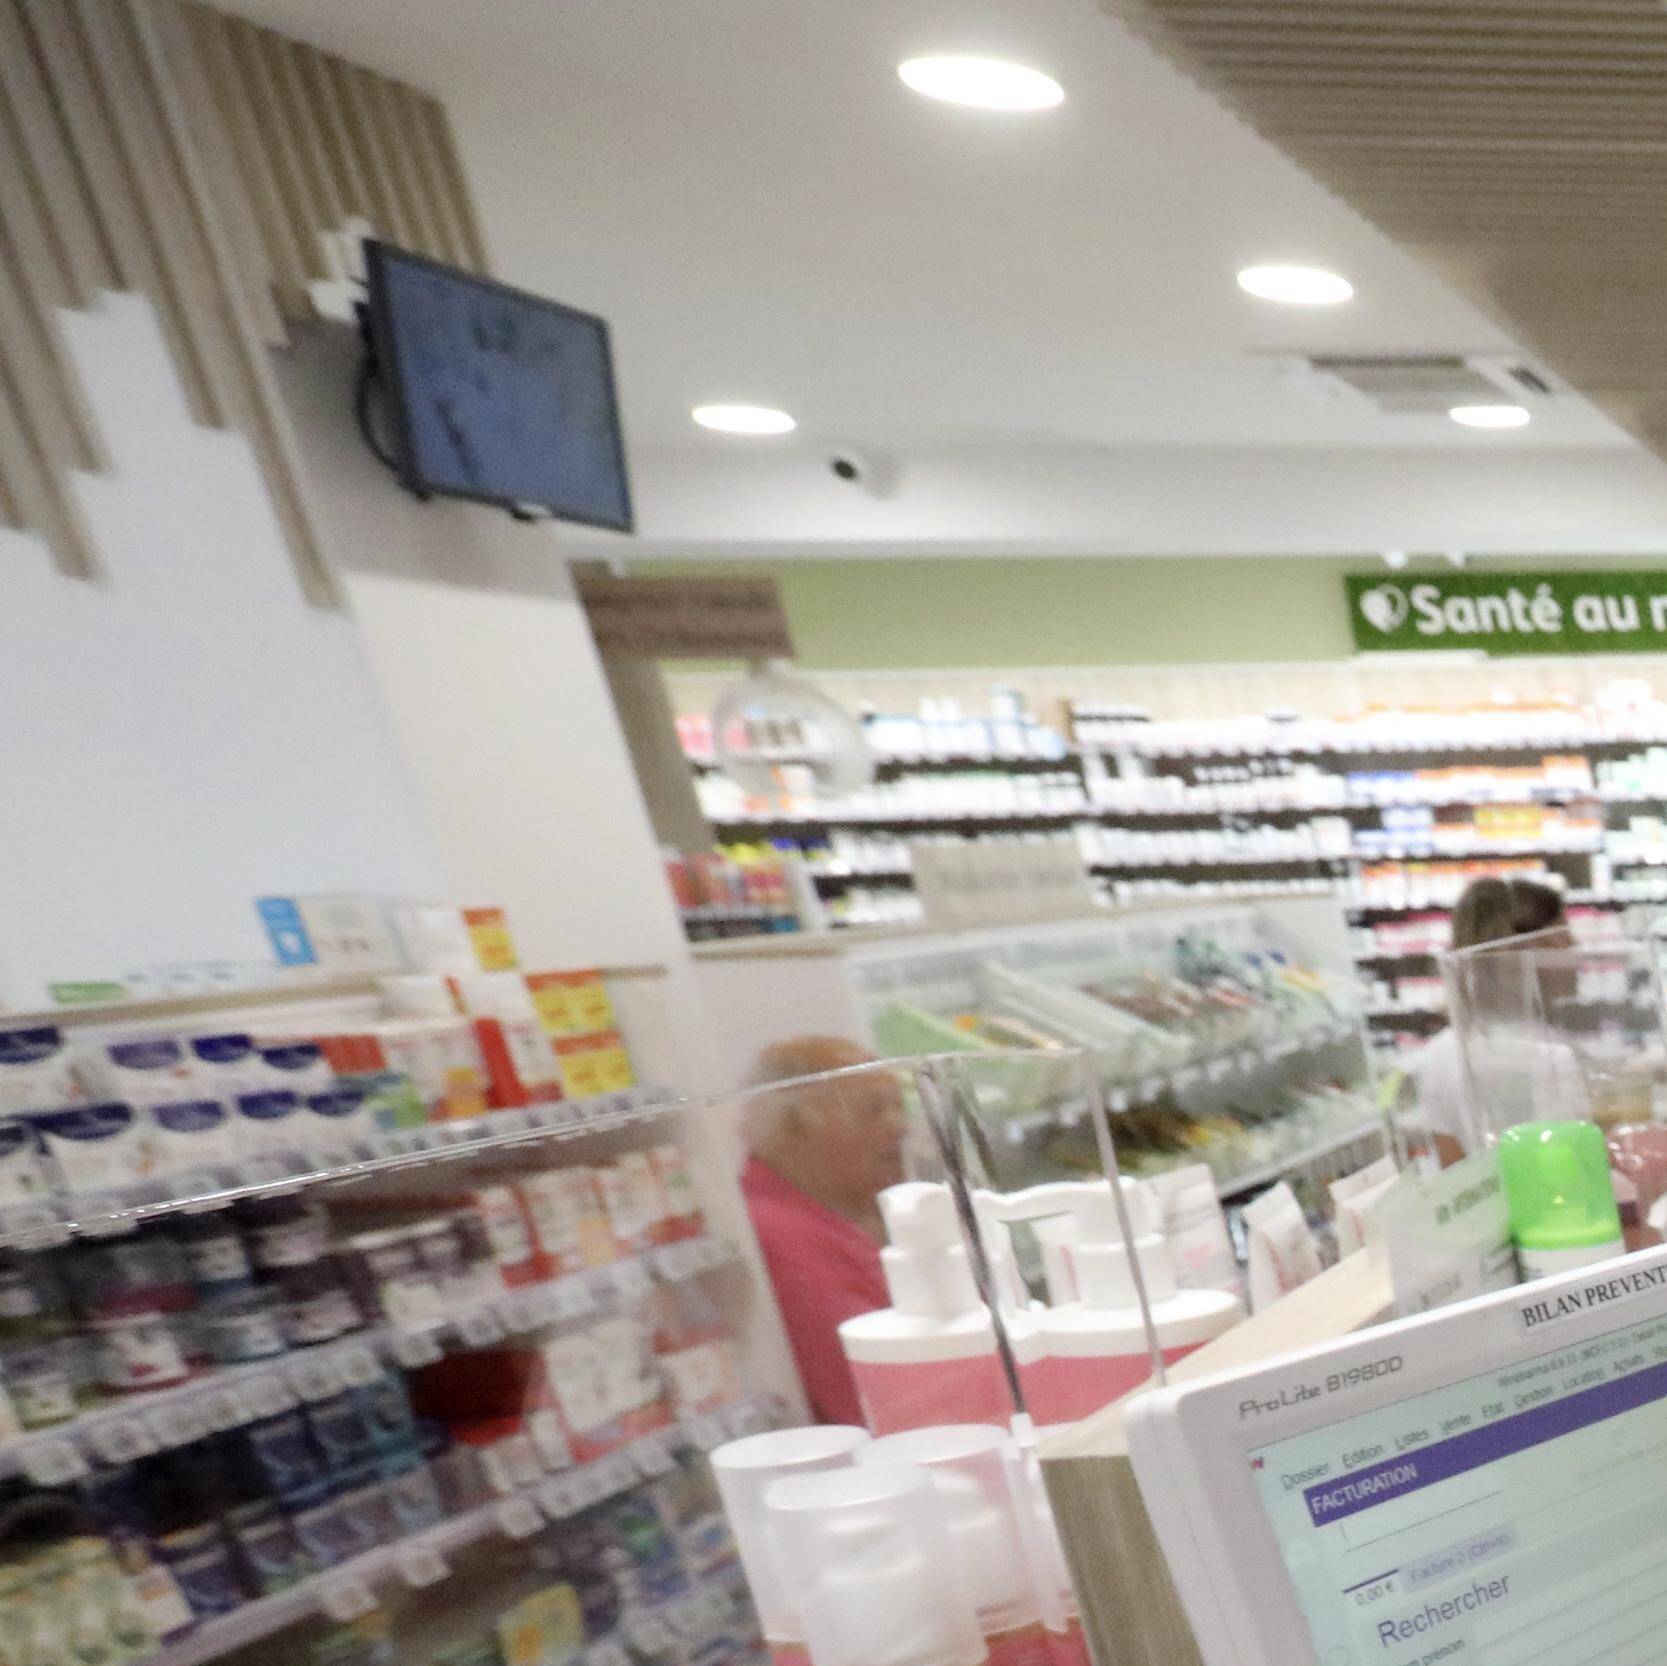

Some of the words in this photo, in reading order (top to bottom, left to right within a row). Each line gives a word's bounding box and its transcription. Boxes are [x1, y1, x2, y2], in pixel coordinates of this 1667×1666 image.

[1411, 582, 1563, 635] Santé
[1573, 594, 1640, 632] au
[1521, 1293, 1582, 1328] BILAN
[1238, 1383, 1323, 1422] ProLite
[1278, 1458, 1332, 1490] Dossier
[1309, 1462, 1419, 1515] FACTURATION
[1373, 1567, 1513, 1651] Rechercher
